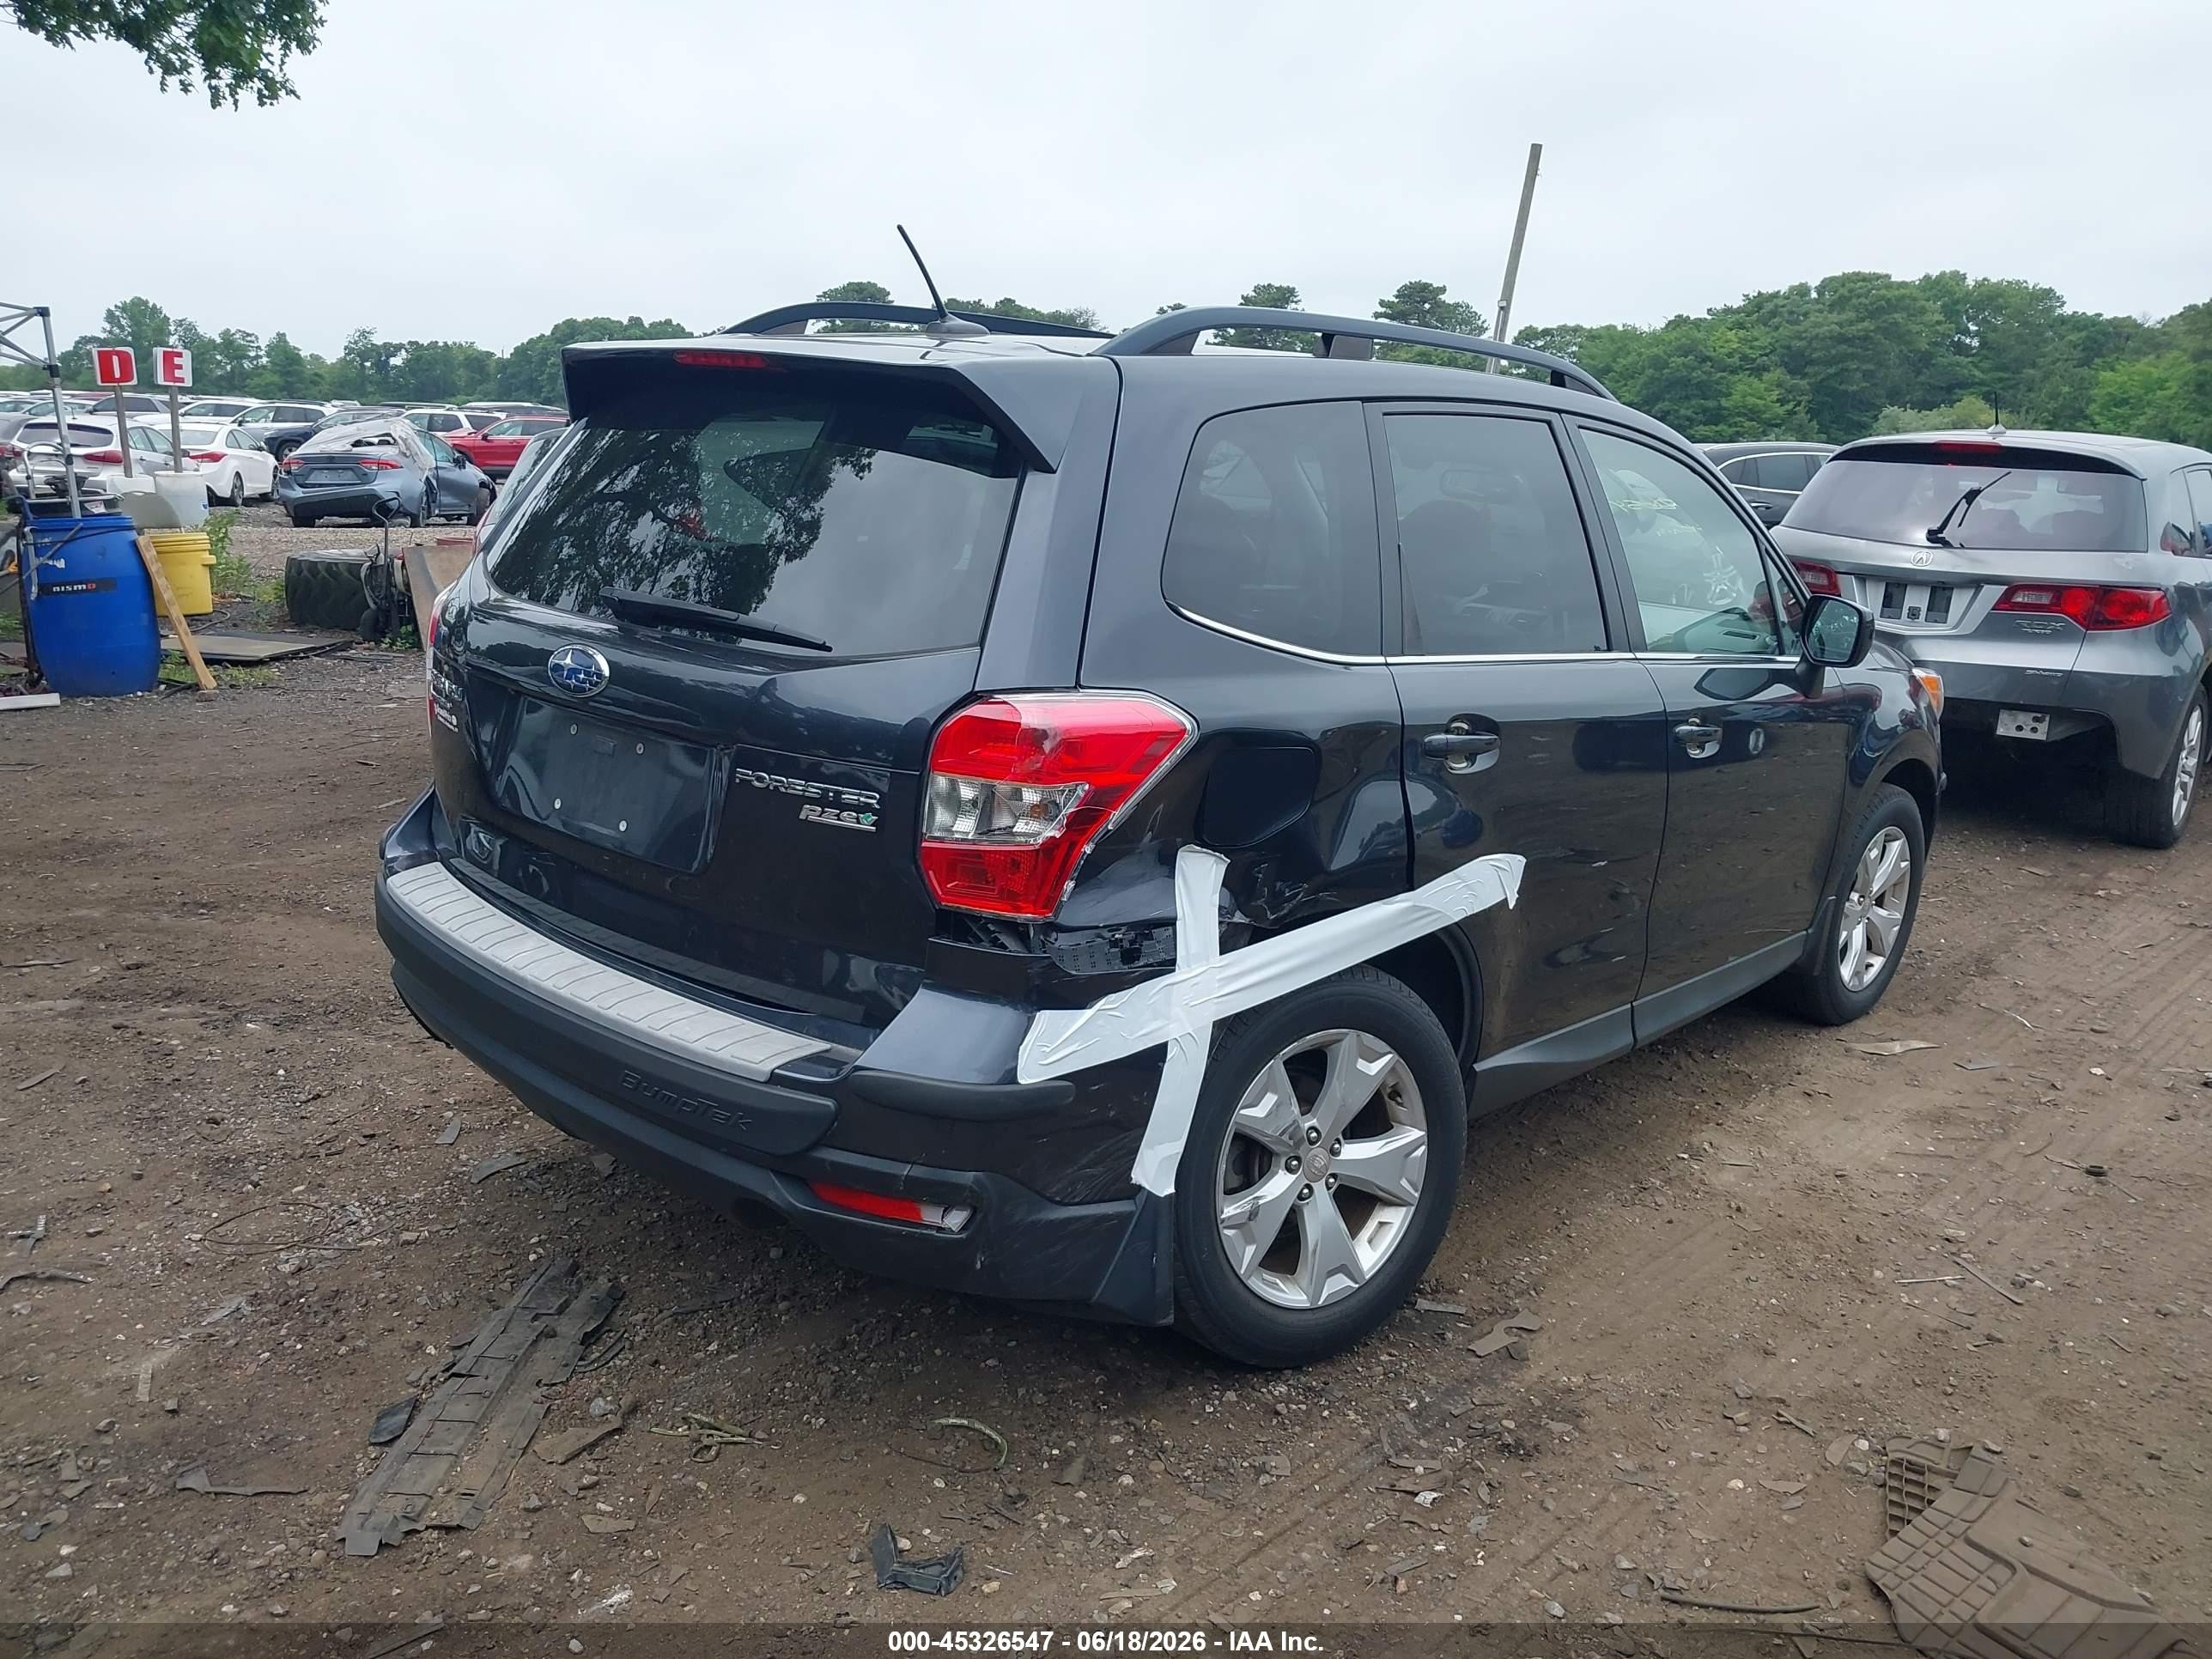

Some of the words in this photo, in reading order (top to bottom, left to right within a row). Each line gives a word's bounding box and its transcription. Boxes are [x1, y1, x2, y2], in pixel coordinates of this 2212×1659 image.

[97, 349, 134, 384] D
[162, 349, 185, 384] E
[735, 768, 881, 809] FORESTER
[620, 1069, 753, 1131] BumpTek
